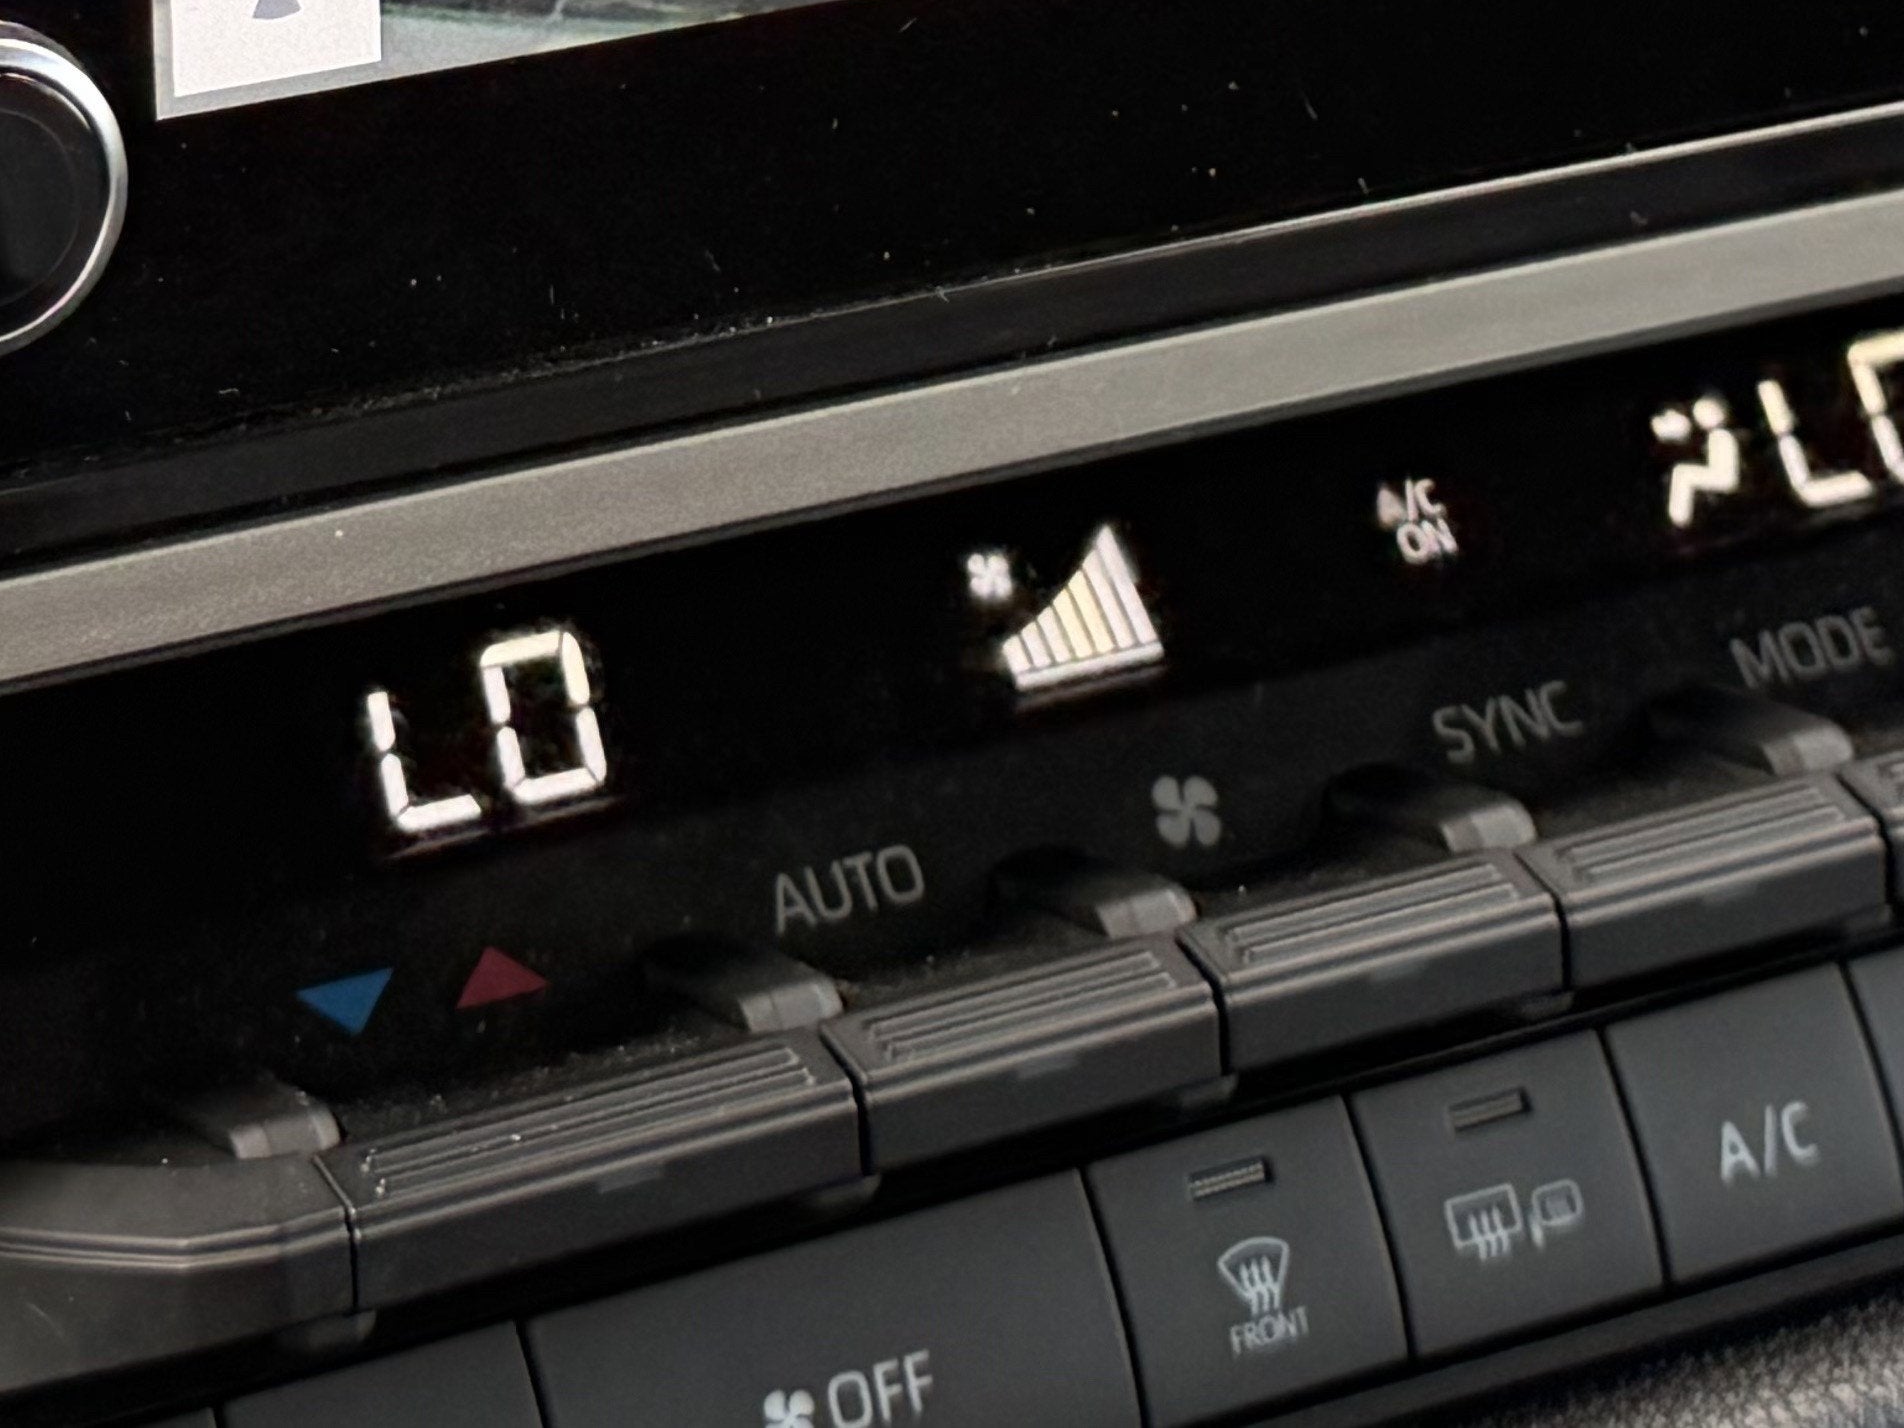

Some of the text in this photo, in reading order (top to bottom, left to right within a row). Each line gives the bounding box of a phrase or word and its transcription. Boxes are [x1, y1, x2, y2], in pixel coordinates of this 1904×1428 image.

[1396, 518, 1458, 565] ON
[1729, 606, 1892, 690] MODE
[365, 629, 609, 834] LO
[1432, 680, 1585, 765] SYNC
[773, 843, 925, 936] AUTO
[1718, 1101, 1819, 1184] A/C
[1229, 1306, 1310, 1356] FRONT
[827, 1349, 934, 1428] OFF
